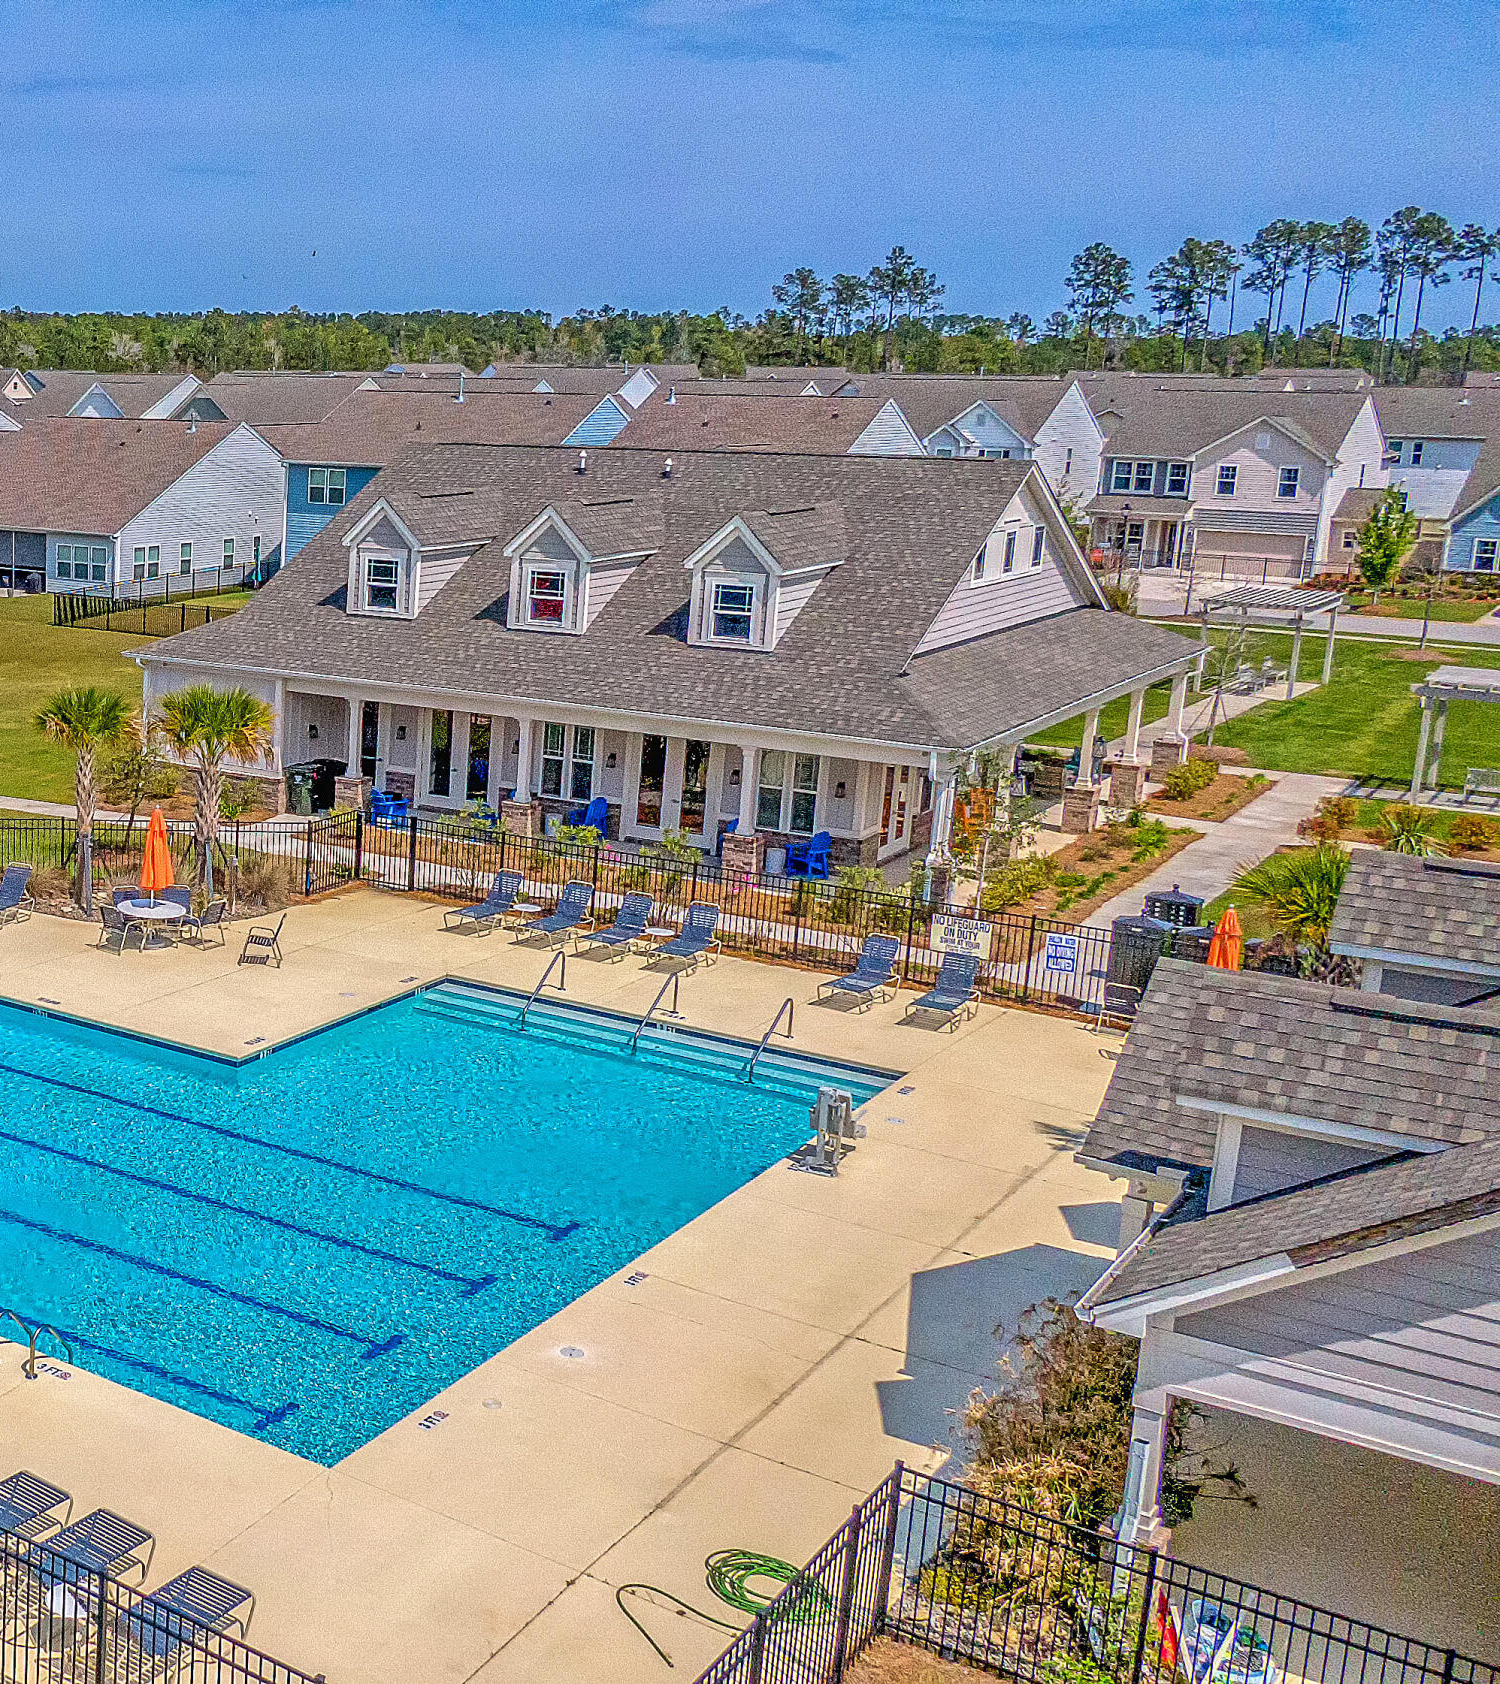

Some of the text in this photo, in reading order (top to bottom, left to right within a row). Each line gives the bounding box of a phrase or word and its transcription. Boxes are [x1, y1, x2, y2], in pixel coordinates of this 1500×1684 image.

[934, 914, 991, 933] NO LIFEGUARD
[944, 927, 978, 941] ON DUTY
[940, 937, 956, 945] SWIM
[965, 941, 981, 949] YOUR
